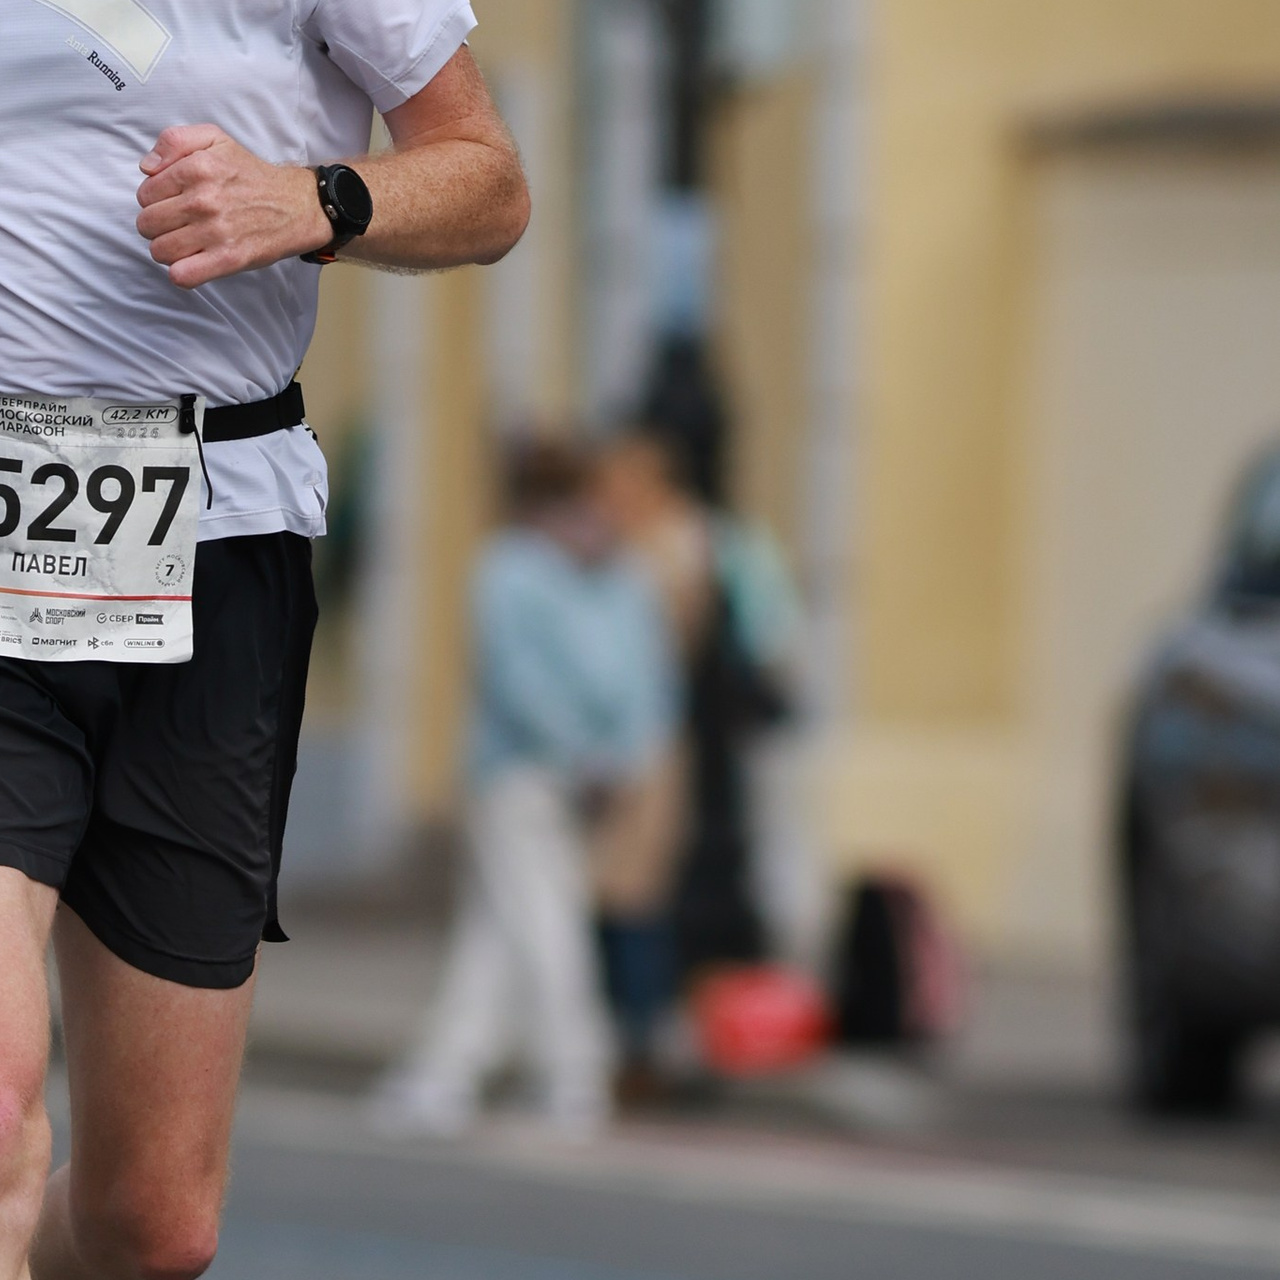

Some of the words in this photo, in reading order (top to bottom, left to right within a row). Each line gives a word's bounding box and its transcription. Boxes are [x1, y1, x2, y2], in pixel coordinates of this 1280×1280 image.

[87, 50, 126, 91] Running
[110, 409, 141, 421] 42,2
[12, 551, 87, 577] ПАВЕЛ
[165, 564, 175, 577] 7
[46, 608, 86, 618] МОСКОВСКИЙ
[109, 614, 134, 622] СБЕР
[45, 617, 65, 625] СПОРТ
